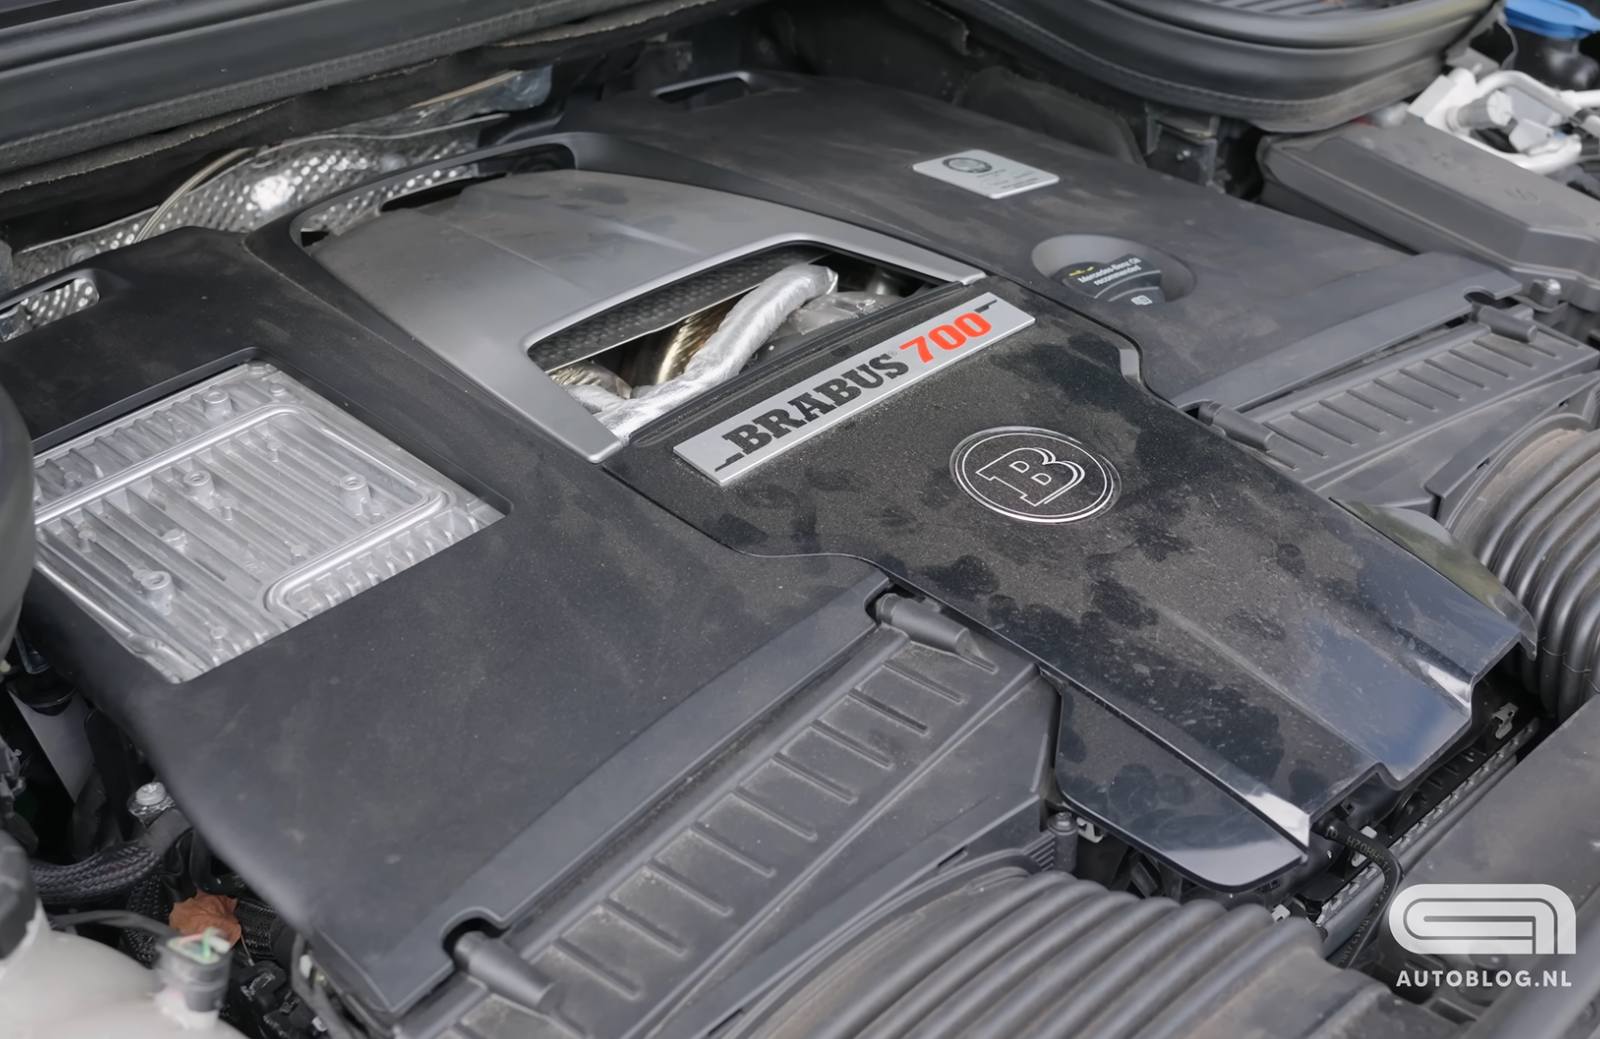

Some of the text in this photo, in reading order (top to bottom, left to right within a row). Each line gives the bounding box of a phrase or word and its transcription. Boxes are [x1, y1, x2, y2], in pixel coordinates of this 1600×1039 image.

[722, 311, 992, 456] BRABUS 700
[976, 447, 1085, 507] B
